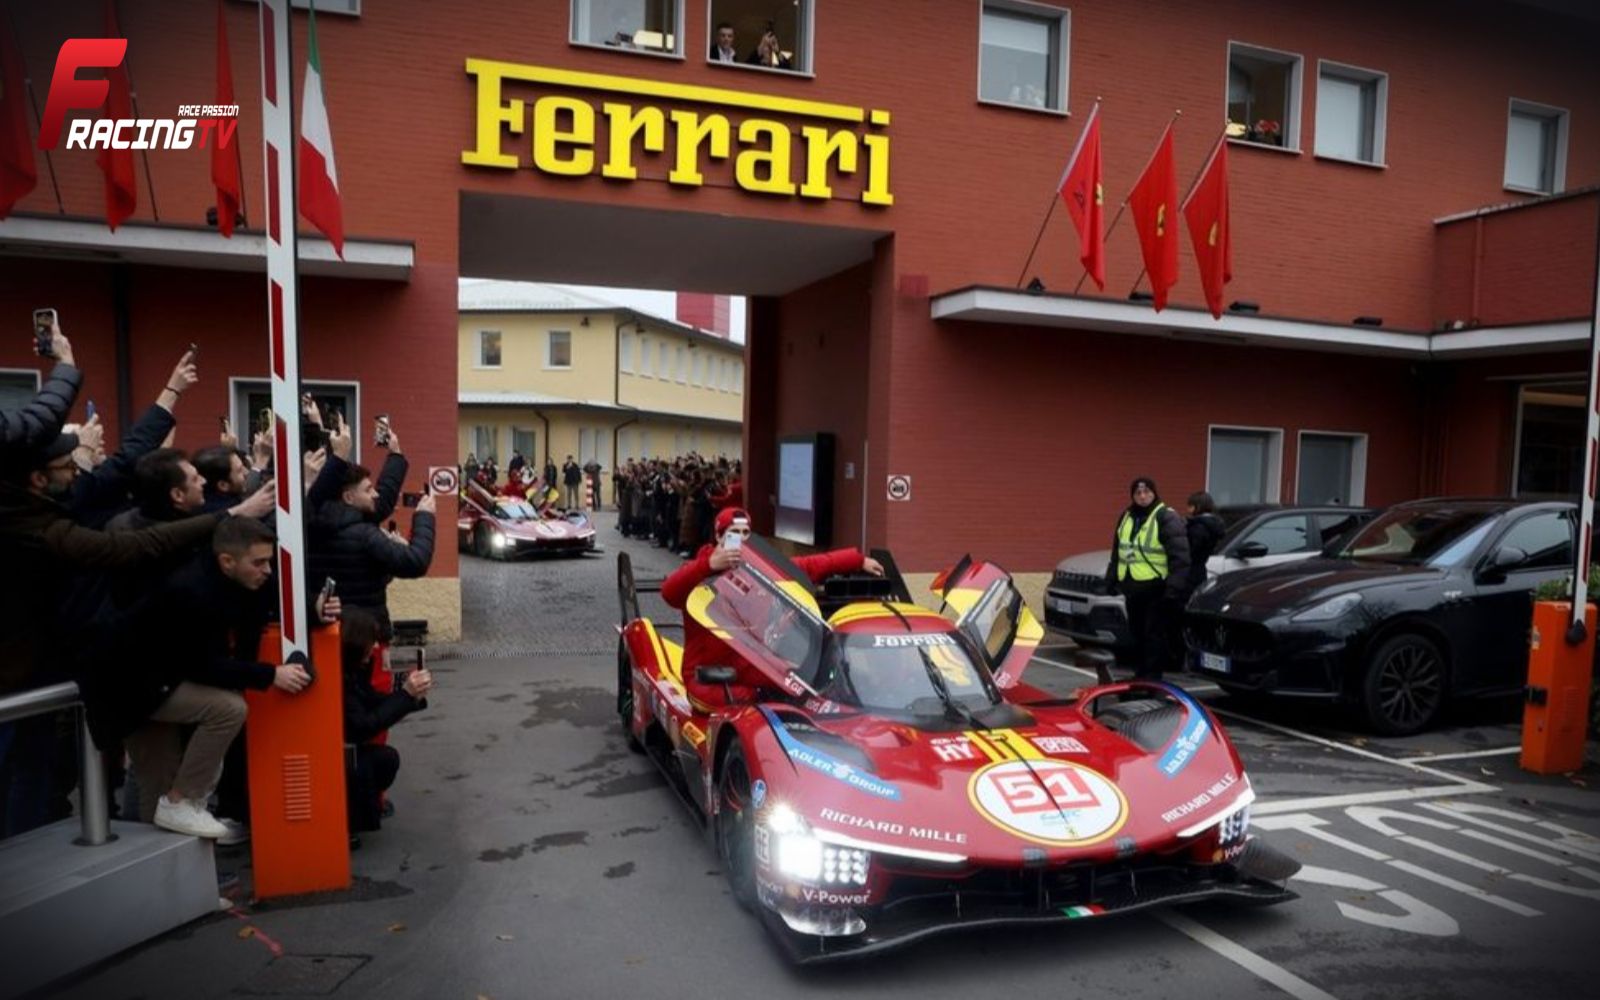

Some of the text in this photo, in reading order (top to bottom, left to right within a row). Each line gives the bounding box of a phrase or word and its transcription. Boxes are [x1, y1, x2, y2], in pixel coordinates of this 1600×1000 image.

[461, 57, 894, 205] Ferrari
[788, 748, 896, 796] ADLER GROUP
[996, 771, 1092, 808] 51
[1161, 772, 1239, 823] RICHARD MILLE
[820, 807, 968, 844] RICHARD MILLE
